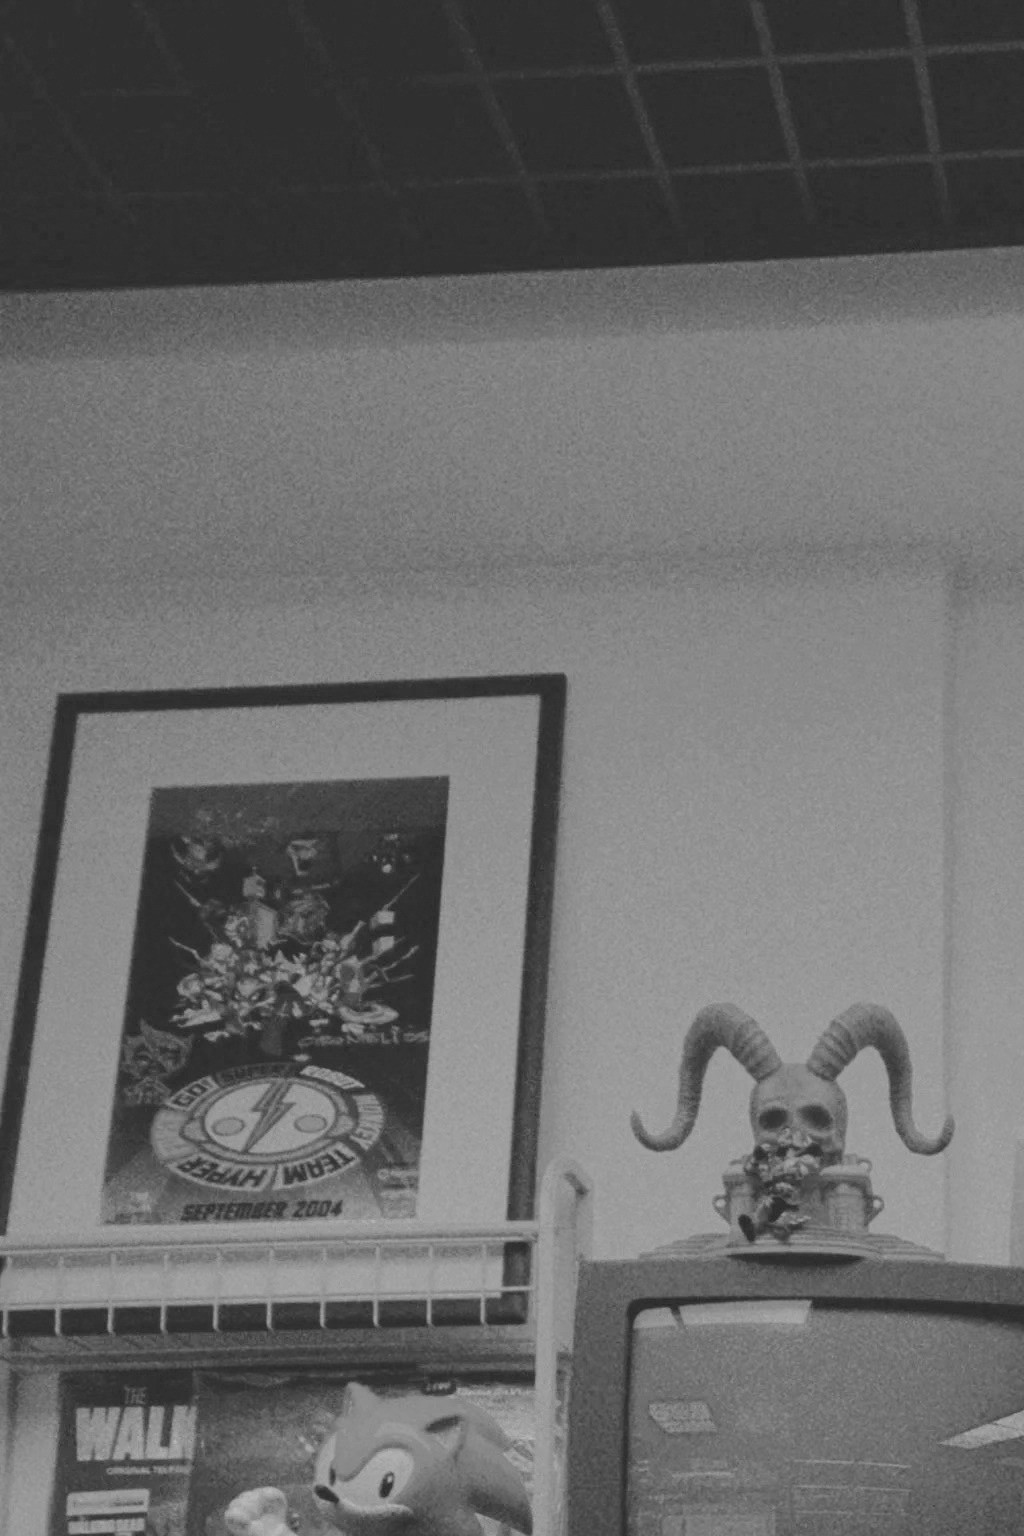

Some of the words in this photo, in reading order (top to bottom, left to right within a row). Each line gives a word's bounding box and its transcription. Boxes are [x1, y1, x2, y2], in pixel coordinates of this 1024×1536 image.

[177, 1155, 266, 1187] HYPER
[284, 1148, 356, 1185] TEAM
[180, 1200, 288, 1222] SEPTEMBER
[293, 1199, 344, 1219] 2004
